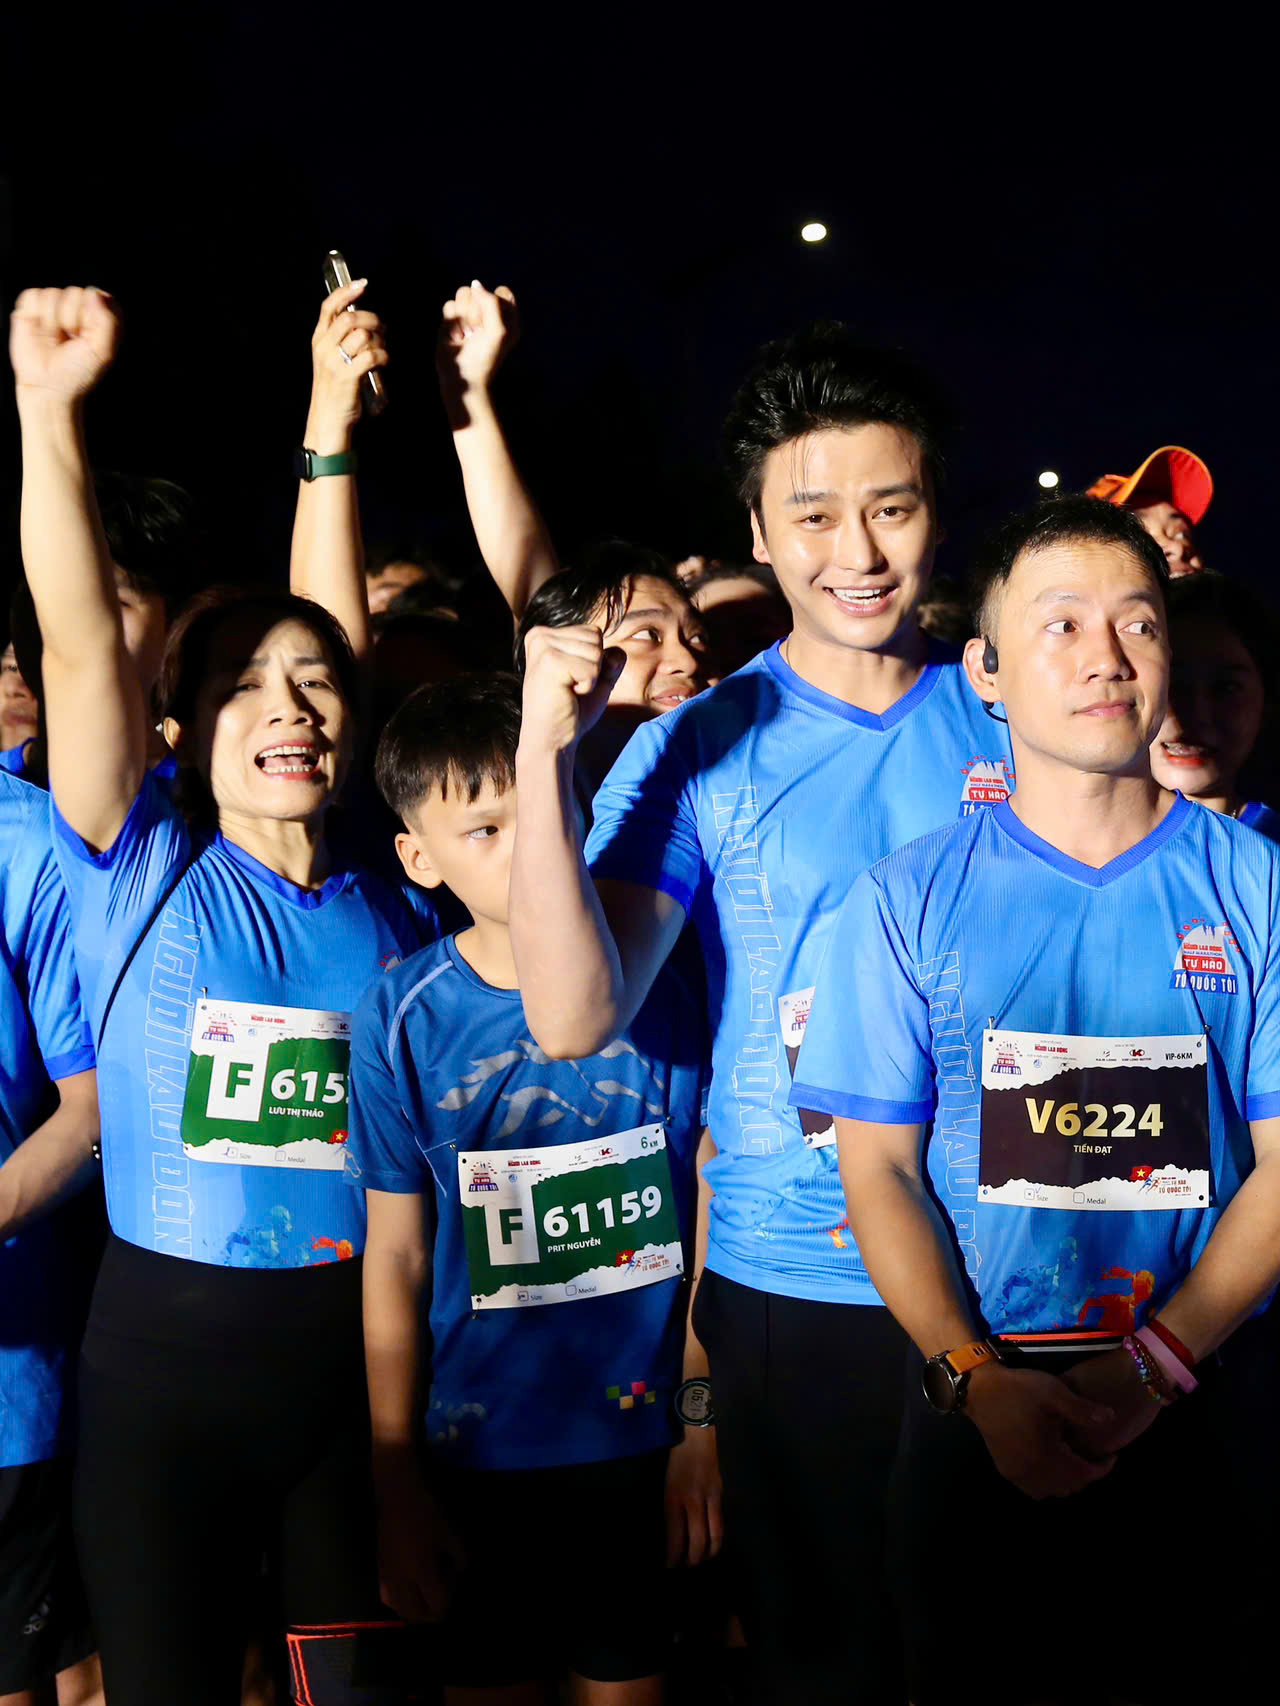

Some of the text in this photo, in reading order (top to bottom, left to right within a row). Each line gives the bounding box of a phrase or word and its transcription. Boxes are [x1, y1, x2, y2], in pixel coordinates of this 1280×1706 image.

[1165, 1052, 1193, 1060] VIP-6KM
[226, 1062, 254, 1098] F
[271, 1069, 349, 1104] 615
[1025, 1097, 1164, 1138] V6224
[640, 1137, 648, 1149] 6
[1073, 1143, 1112, 1156] TIẾN ĐẠT
[543, 1185, 662, 1237] 61159
[499, 1208, 524, 1245] F
[547, 1244, 565, 1253] PRIT
[578, 1286, 597, 1294] Medal
